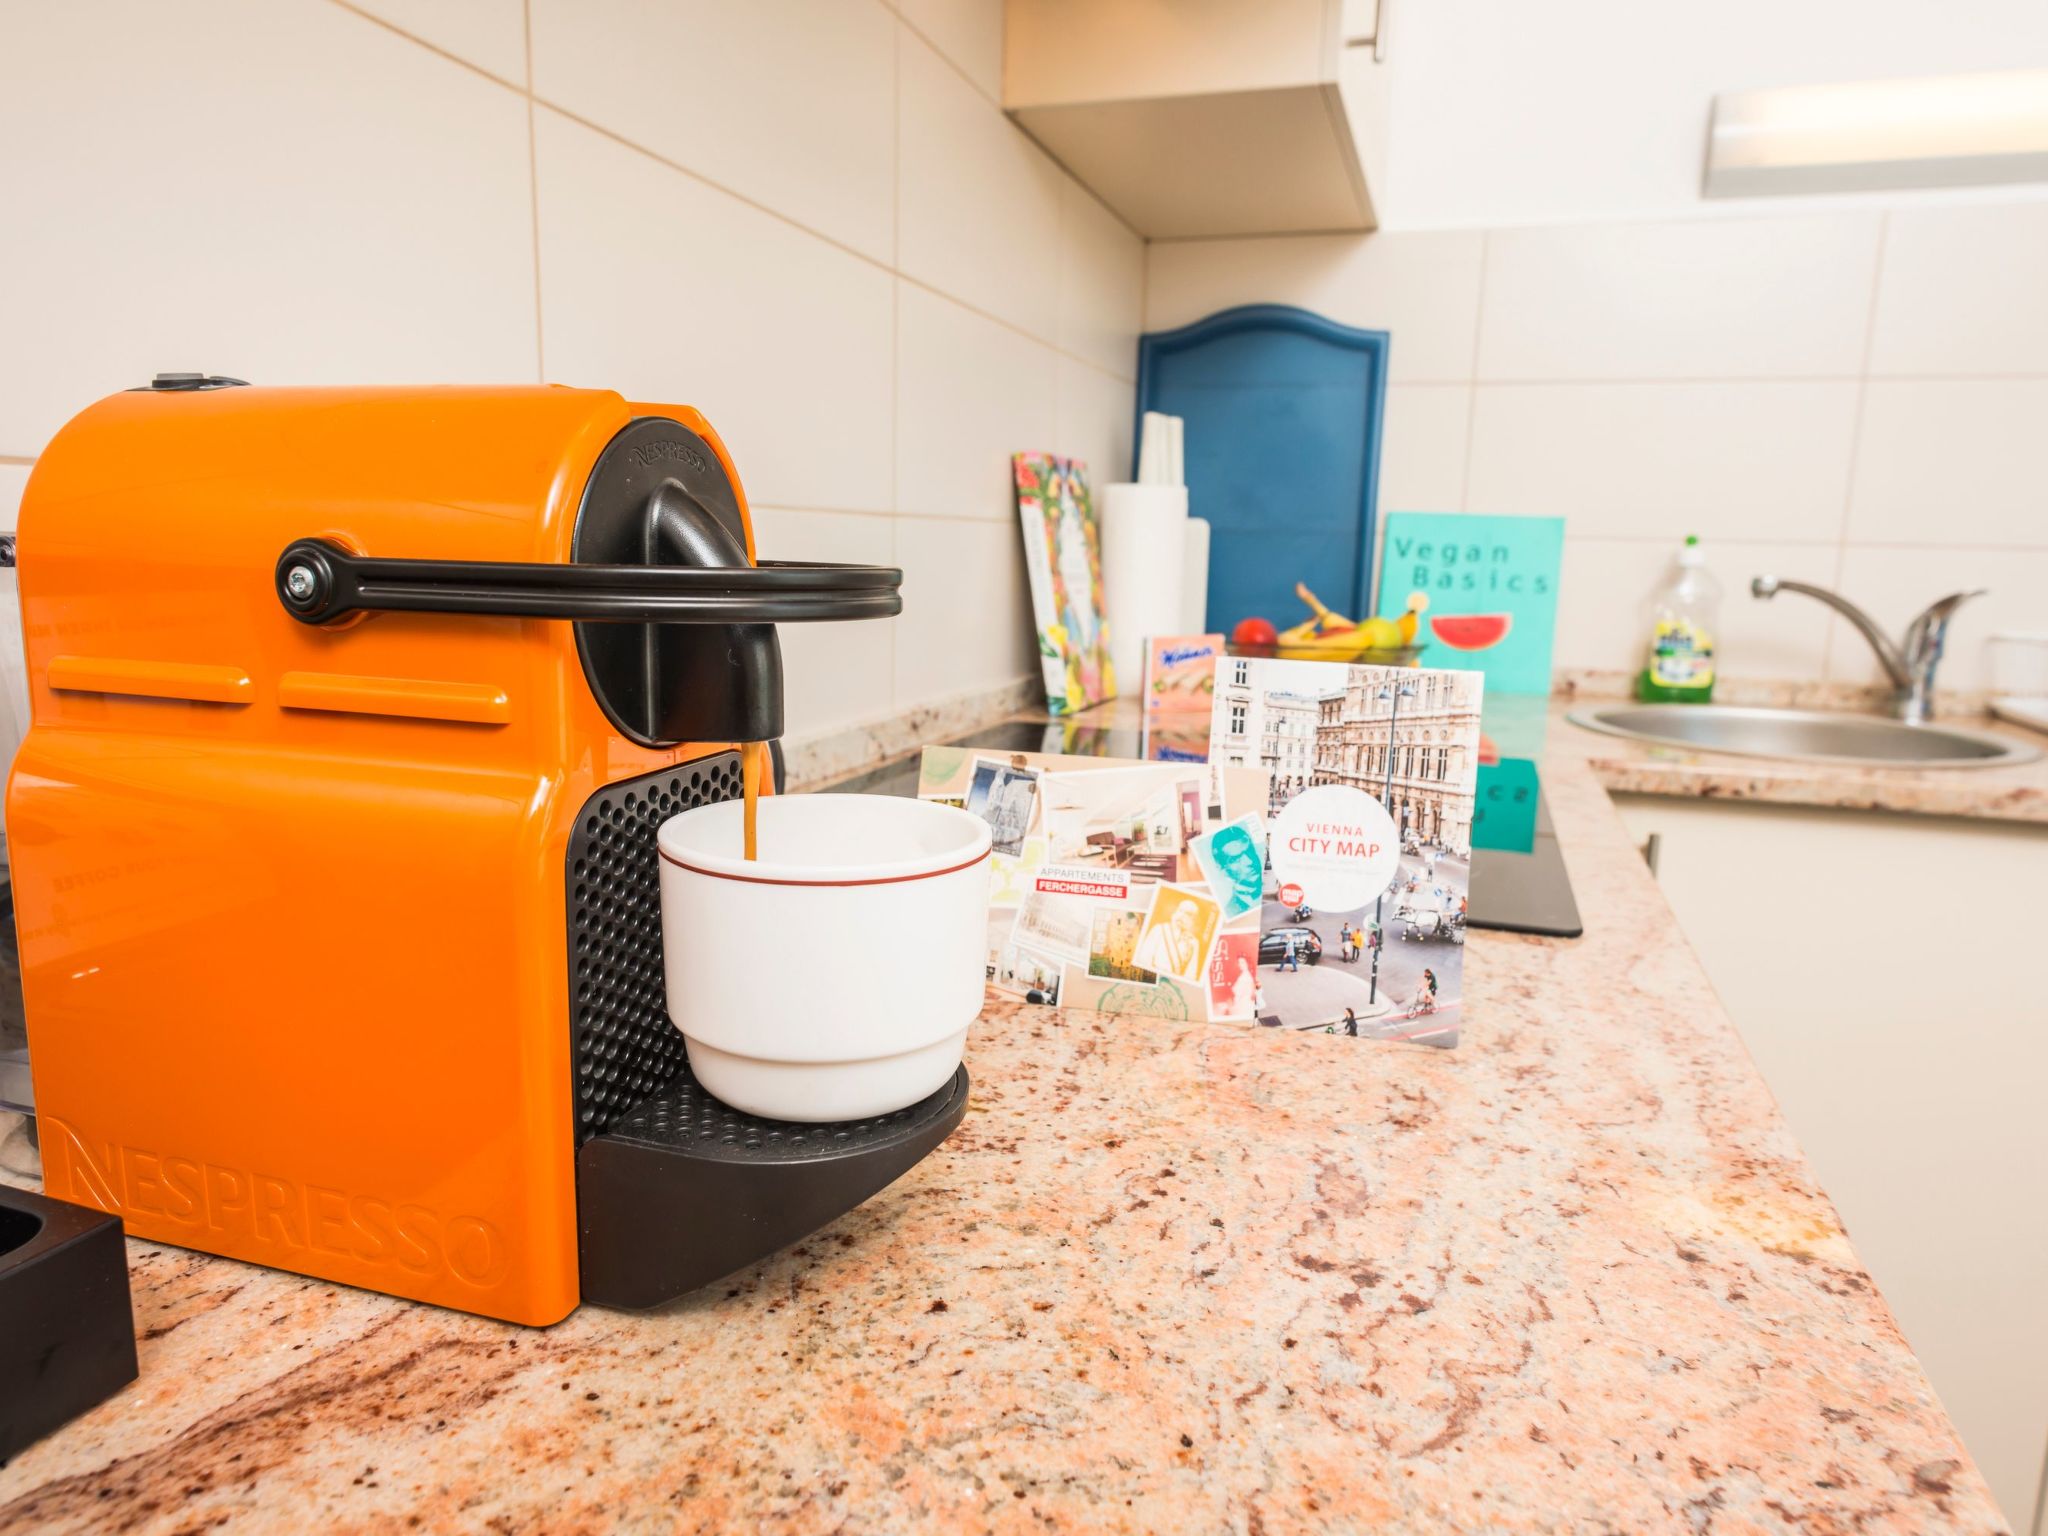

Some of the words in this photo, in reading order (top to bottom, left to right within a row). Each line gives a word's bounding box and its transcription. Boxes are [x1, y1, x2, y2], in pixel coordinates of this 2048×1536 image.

[632, 440, 706, 472] NESPRESSO
[1395, 537, 1509, 566] Vegan
[1412, 566, 1548, 594] Basics
[1306, 823, 1363, 836] VIENNA
[1289, 837, 1330, 854] CITY
[1337, 841, 1380, 858] MAP
[1039, 880, 1124, 898] FERCHERGASSE
[1040, 867, 1125, 883] APPARTEMENTS
[1213, 939, 1231, 987] Sissi
[46, 1116, 508, 1288] NESPRESSO
